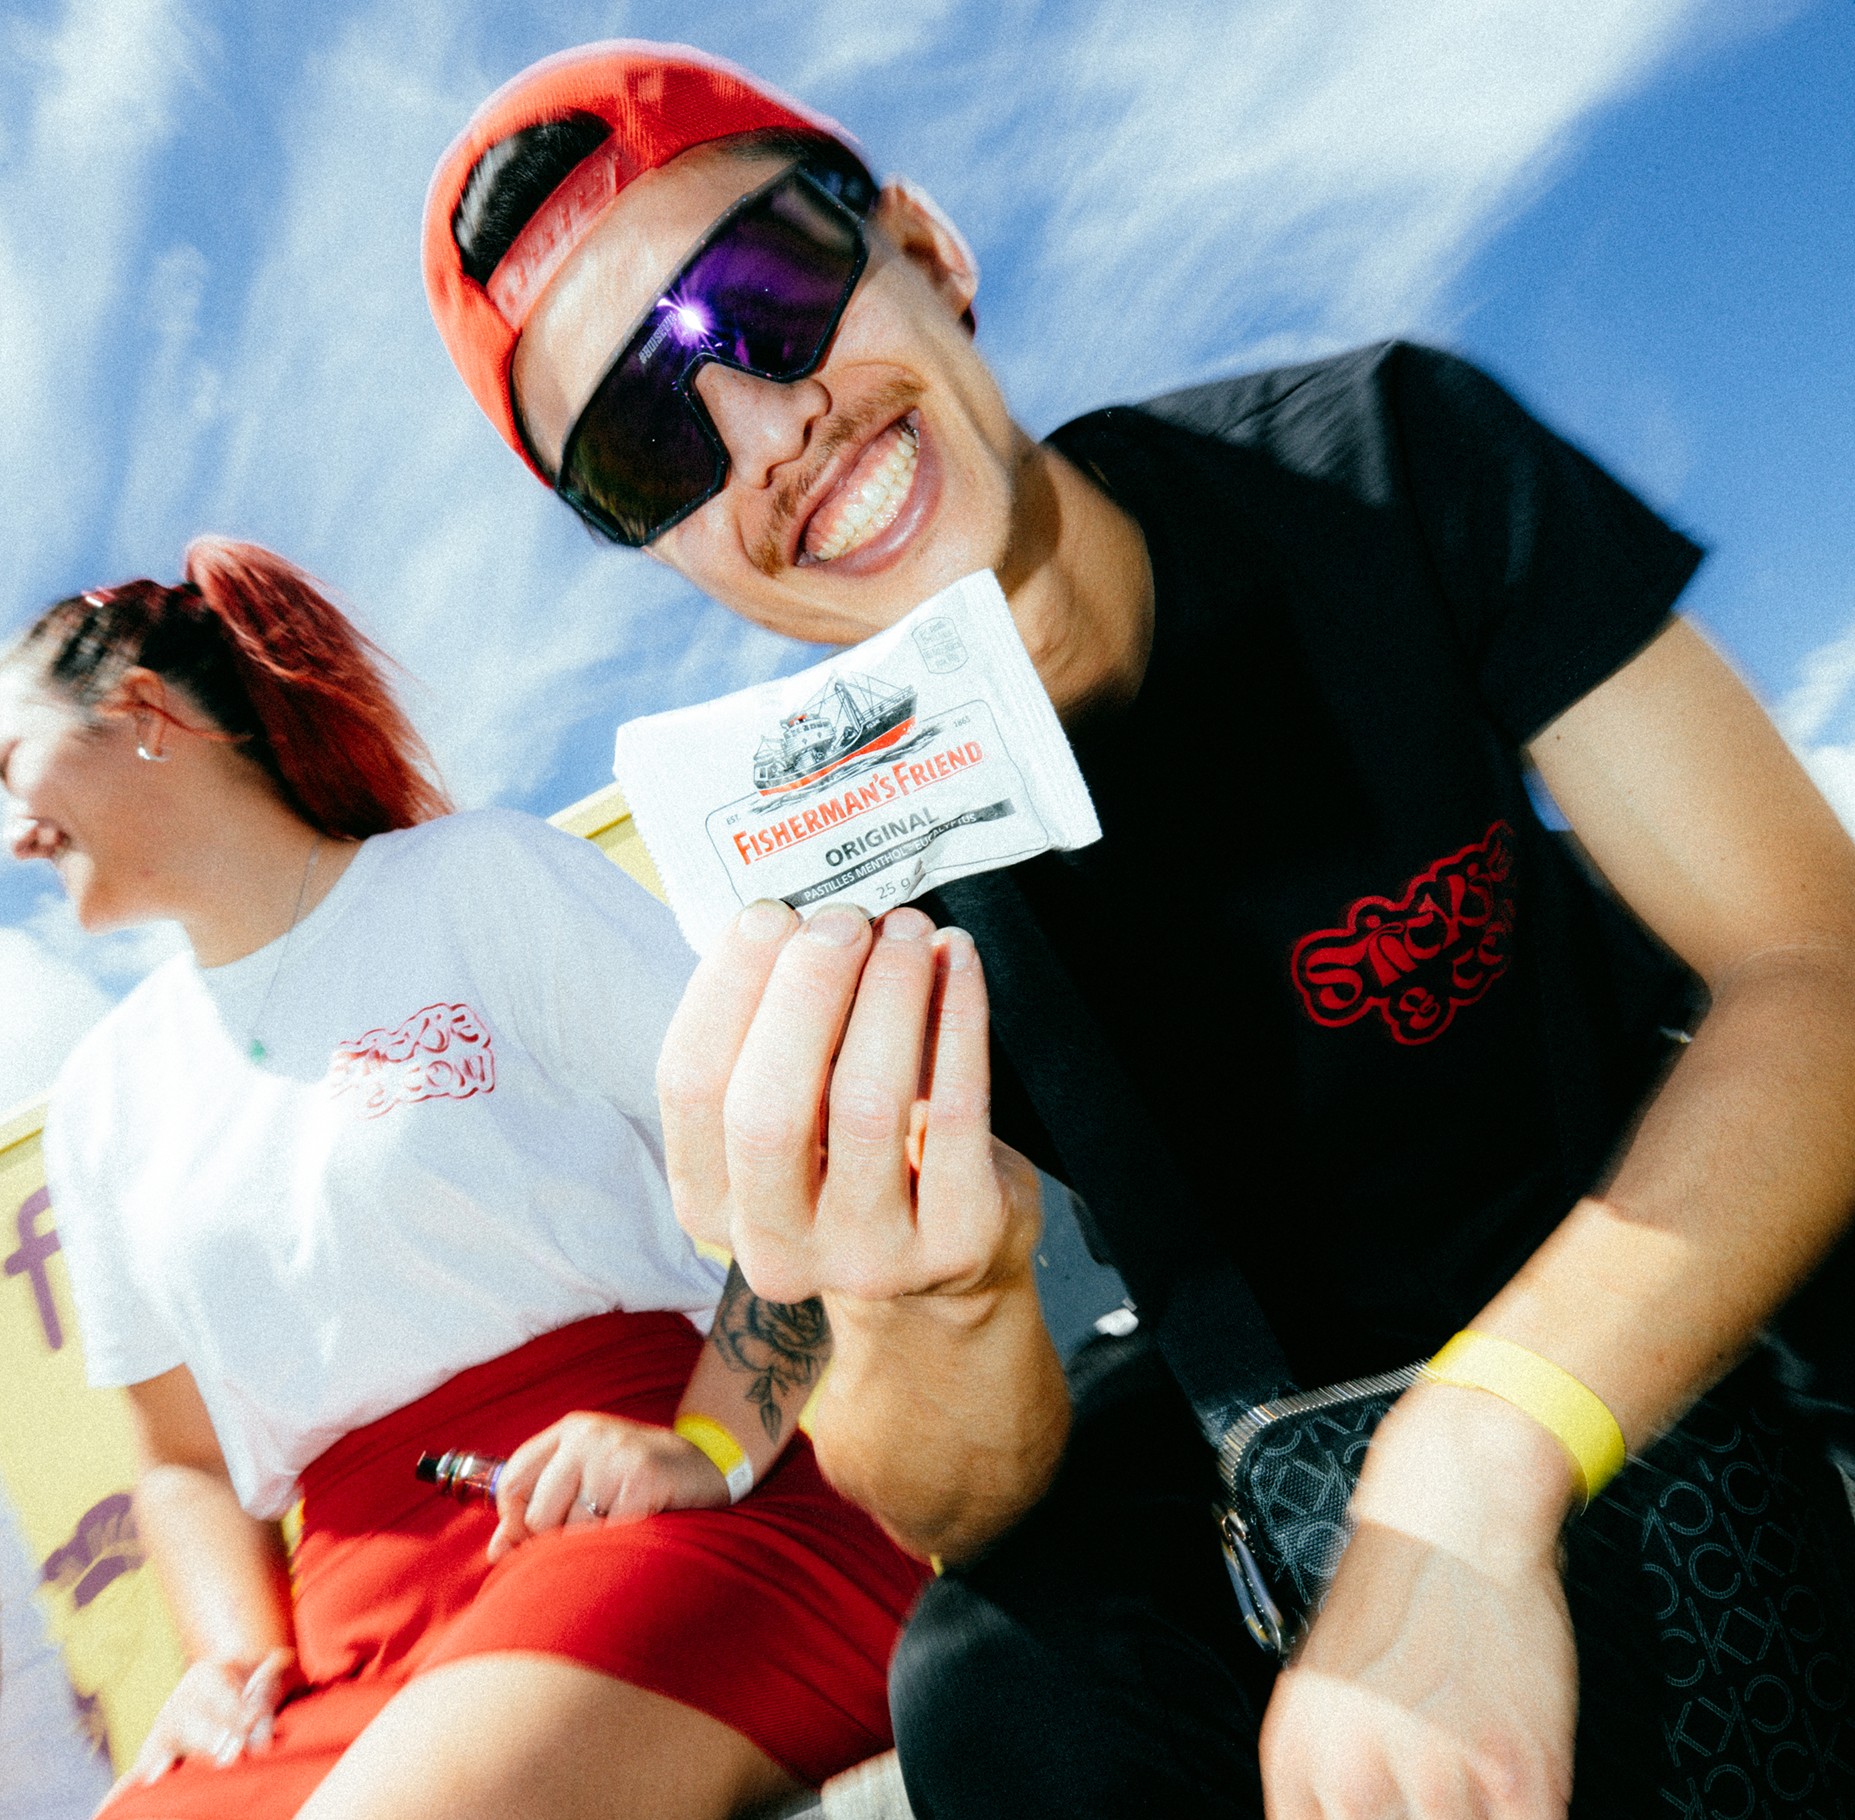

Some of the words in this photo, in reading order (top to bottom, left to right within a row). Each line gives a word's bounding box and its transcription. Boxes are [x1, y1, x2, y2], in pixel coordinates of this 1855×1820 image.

[824, 806, 940, 869] ORIGINAL
[803, 871, 856, 902] PASTILLES
[855, 845, 908, 881] MENTHOL
[876, 881, 899, 901] 25
[900, 876, 912, 893] g
